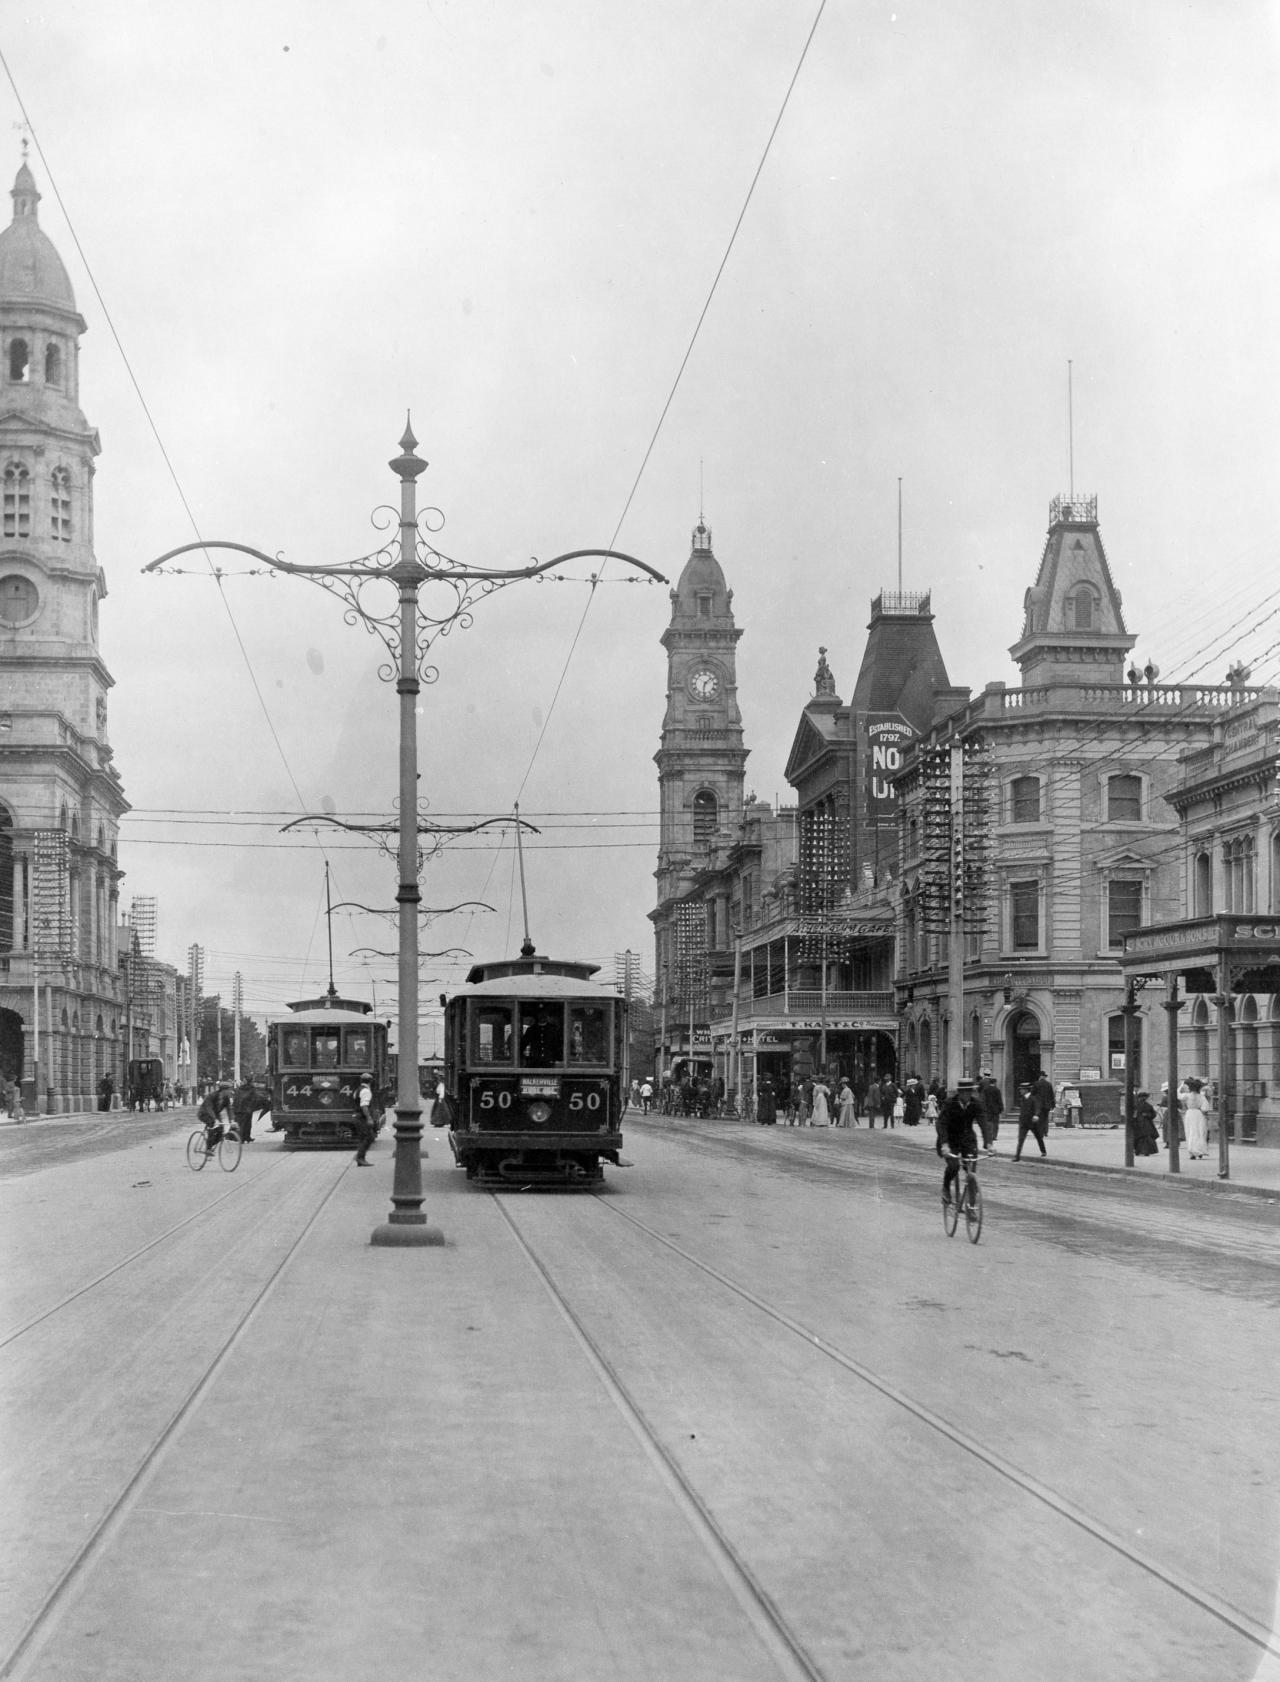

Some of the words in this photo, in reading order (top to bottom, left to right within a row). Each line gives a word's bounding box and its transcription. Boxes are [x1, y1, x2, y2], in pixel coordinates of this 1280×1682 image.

[868, 722, 913, 737] ESTABLISHED
[879, 733, 901, 742] 1797.
[872, 745, 900, 770] NO
[858, 924, 892, 934] CAFE
[747, 1035, 778, 1043] HTEL
[286, 1085, 313, 1096] 44
[339, 1085, 353, 1096] 4
[479, 1091, 512, 1109] 50
[569, 1092, 601, 1110] 50
